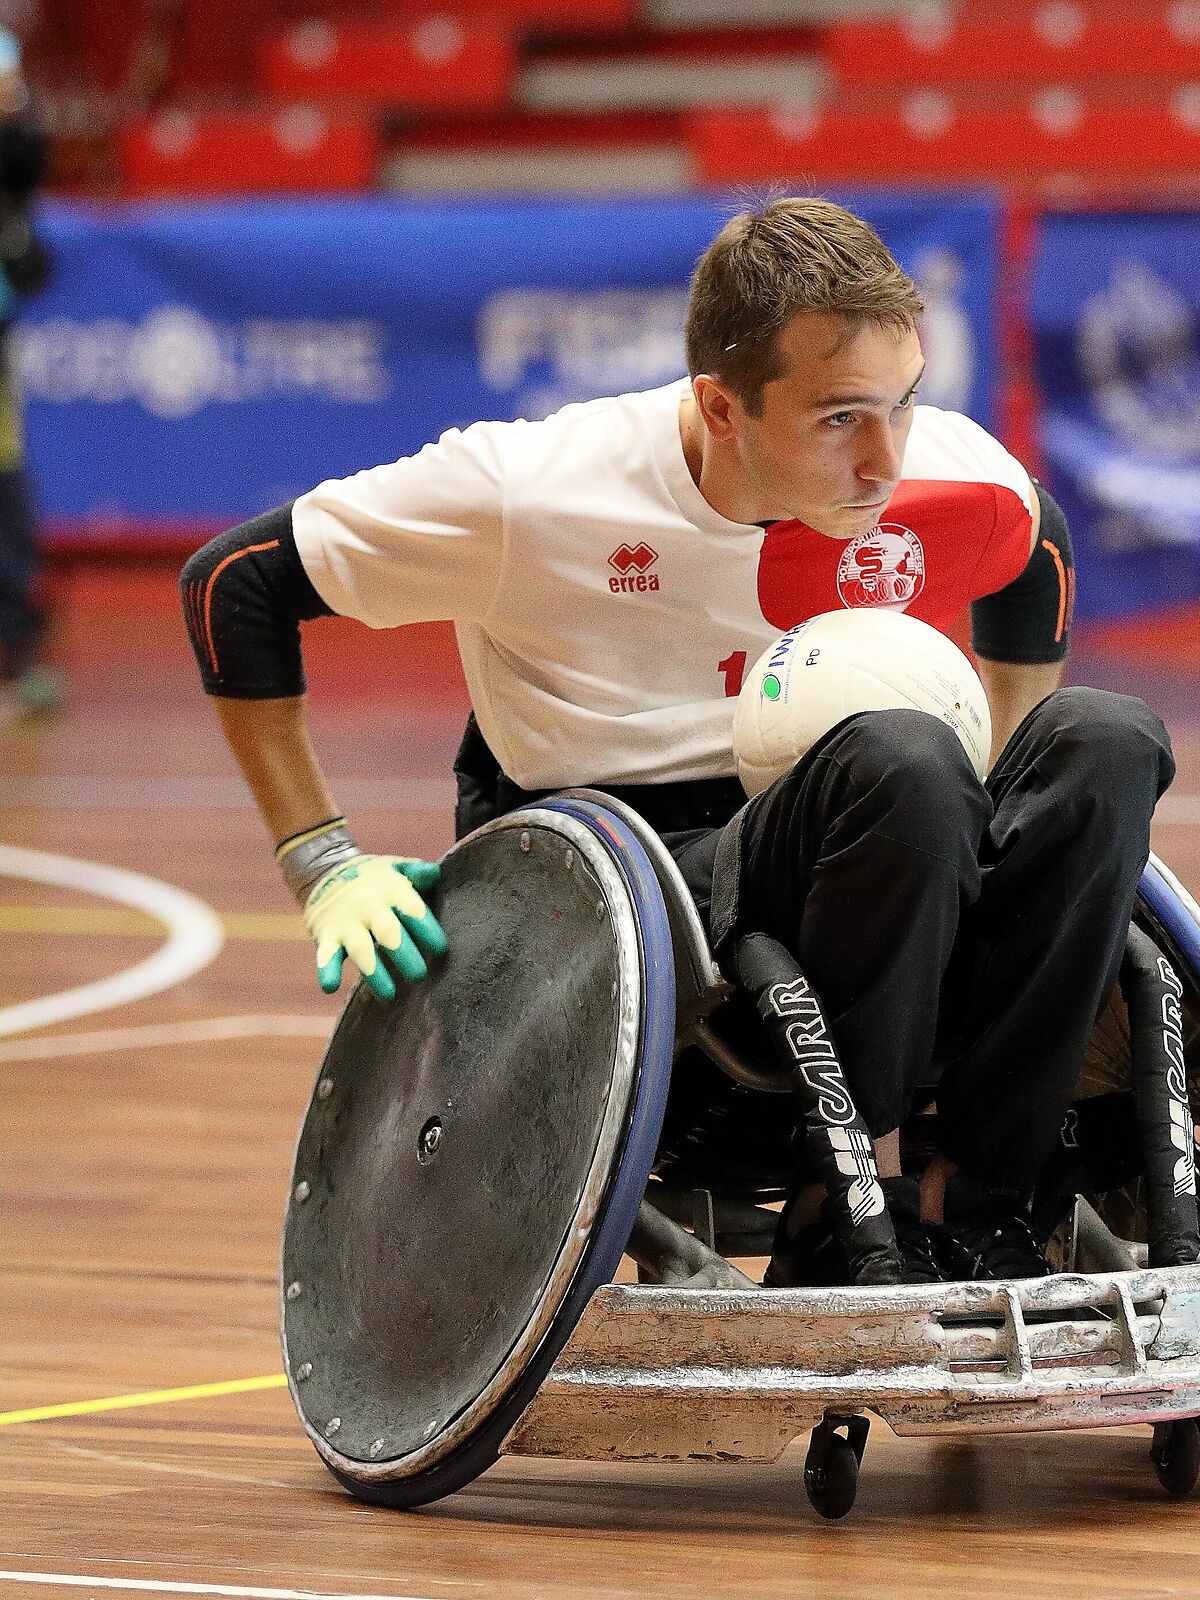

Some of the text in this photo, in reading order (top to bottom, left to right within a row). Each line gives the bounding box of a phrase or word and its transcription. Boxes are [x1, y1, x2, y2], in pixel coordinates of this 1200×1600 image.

[838, 526, 923, 583] POLISPORTIVA MILANESE
[718, 651, 747, 697] 1
